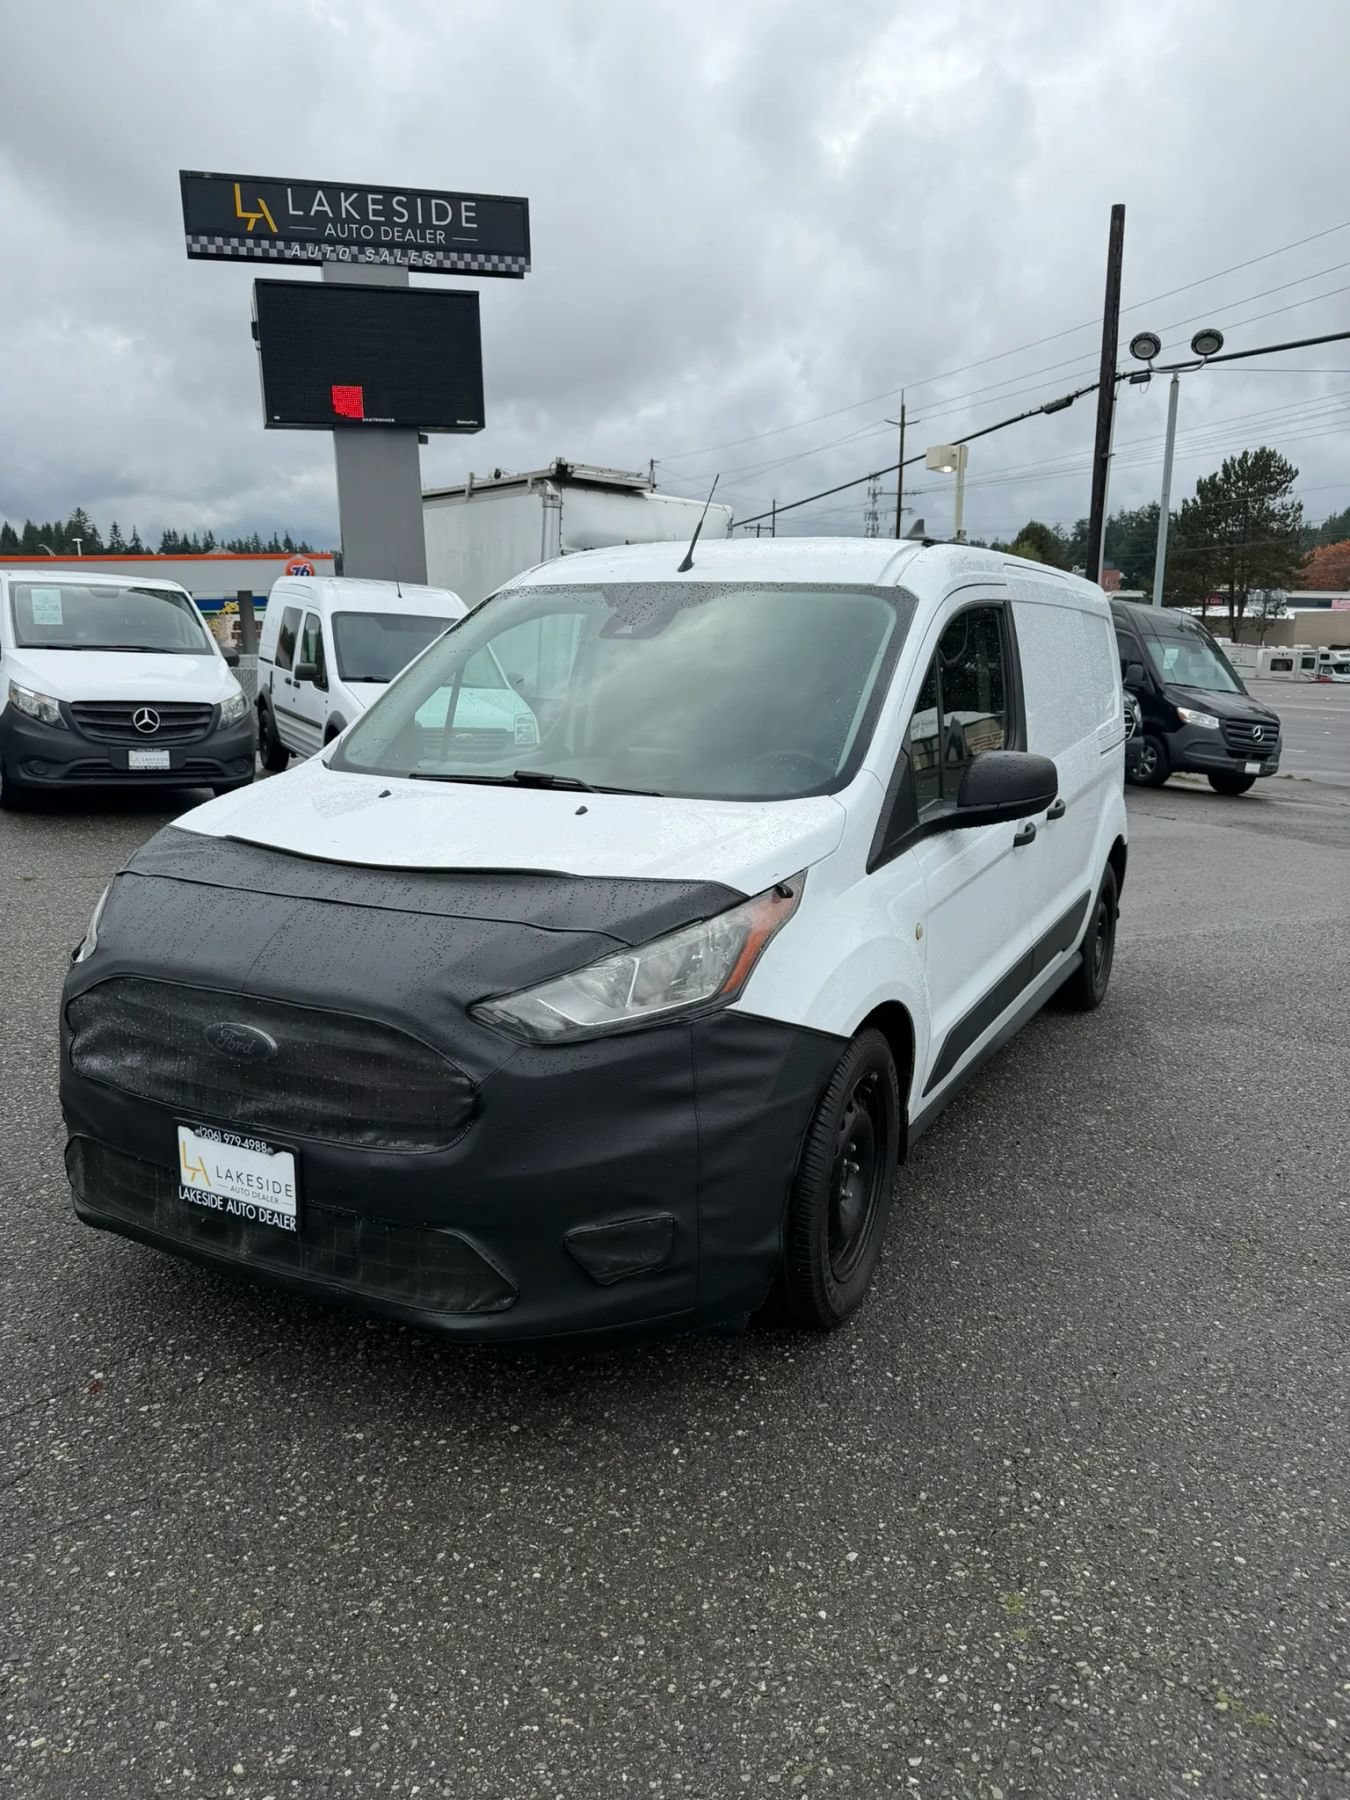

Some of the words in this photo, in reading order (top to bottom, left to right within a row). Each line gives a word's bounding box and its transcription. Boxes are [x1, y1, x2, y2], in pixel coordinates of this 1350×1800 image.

[287, 187, 478, 228] LAKESIDE
[324, 223, 374, 240] AUTO
[380, 226, 446, 245] DEALER
[290, 244, 350, 260] AUTO
[365, 249, 435, 265] SALES
[290, 563, 311, 577] 76
[217, 1028, 256, 1055] Ford
[199, 1126, 221, 1143] (206)
[223, 1133, 267, 1153] 979-4988
[216, 1165, 293, 1198] LAKESIDE
[230, 1185, 250, 1197] AUTO
[251, 1190, 279, 1205] DEALER
[179, 1185, 223, 1211] LAKESIDE
[226, 1202, 256, 1219] AUTO
[258, 1208, 297, 1232] DEALER
